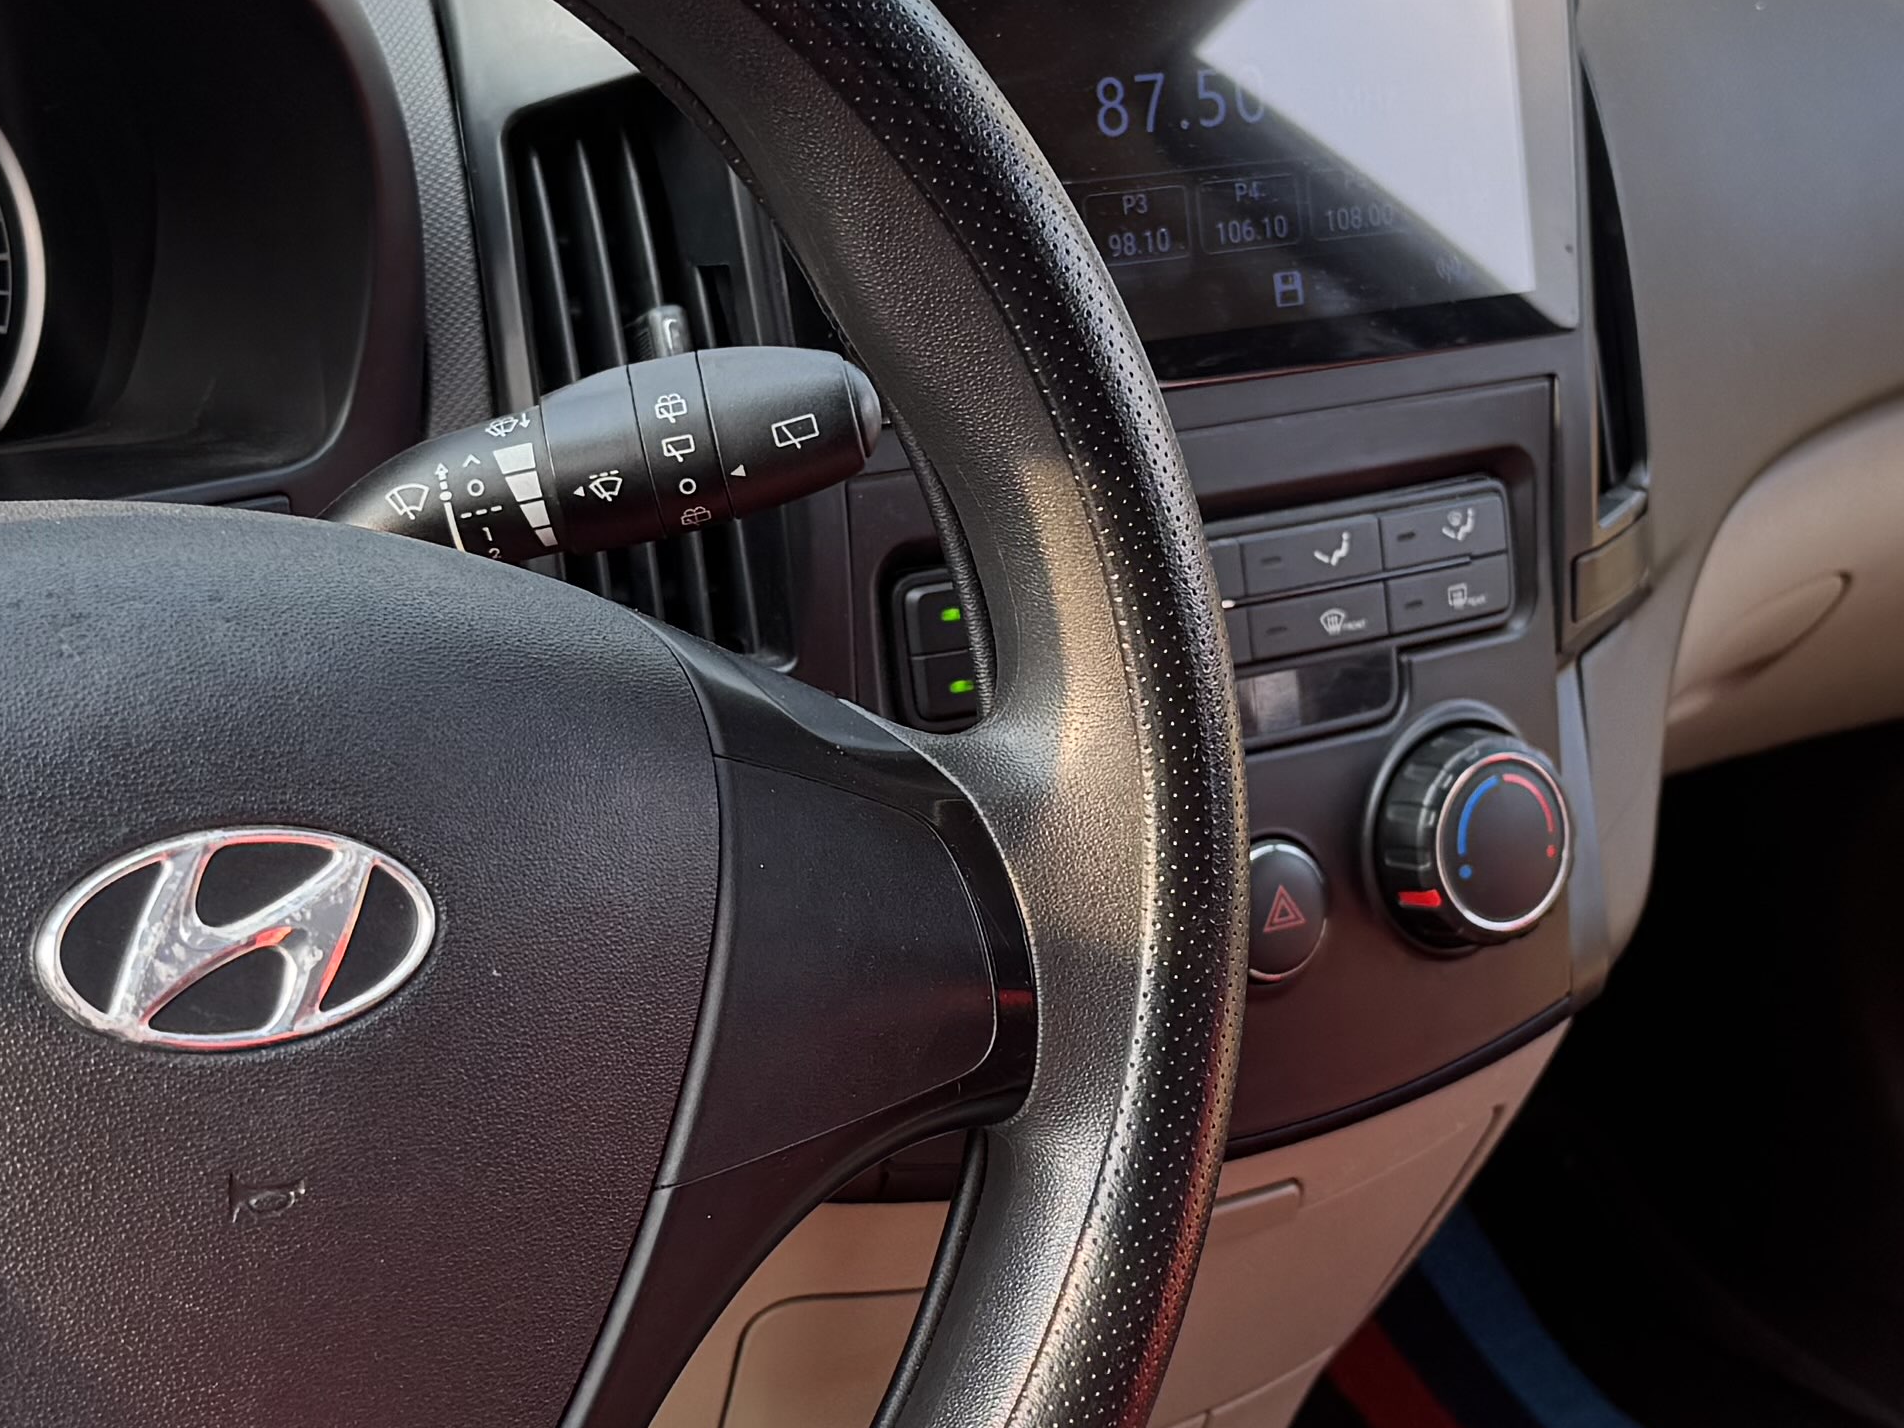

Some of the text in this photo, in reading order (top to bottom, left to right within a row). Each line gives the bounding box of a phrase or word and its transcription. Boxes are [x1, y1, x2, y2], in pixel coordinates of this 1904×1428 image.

[1095, 63, 1266, 139] 87.50
[1121, 193, 1149, 217] P3
[1234, 182, 1262, 203] P4
[1215, 214, 1289, 246] 106.10
[1324, 202, 1394, 233] 108.00
[1107, 227, 1171, 258] 98.10
[482, 526, 493, 542] 1
